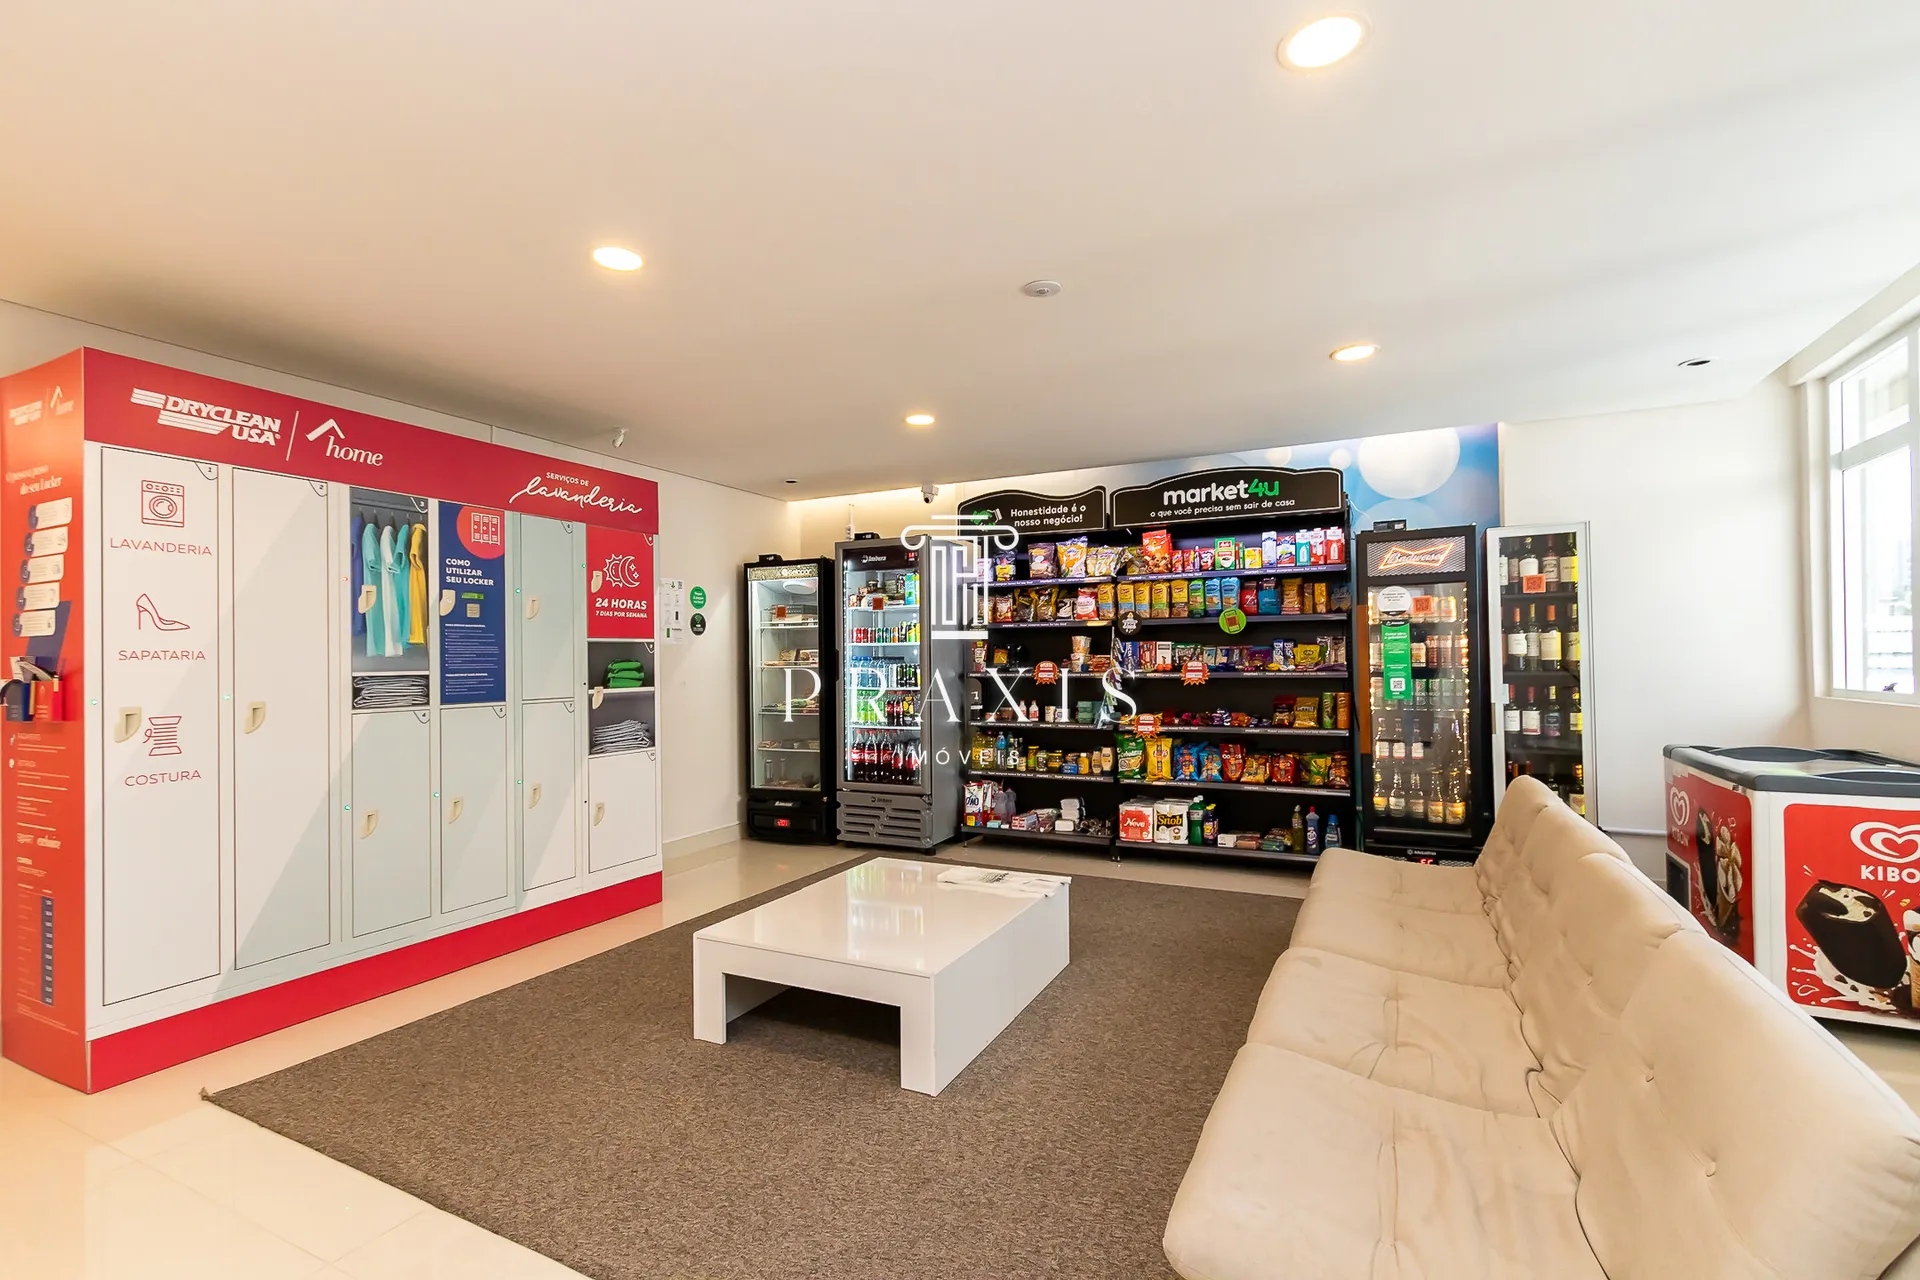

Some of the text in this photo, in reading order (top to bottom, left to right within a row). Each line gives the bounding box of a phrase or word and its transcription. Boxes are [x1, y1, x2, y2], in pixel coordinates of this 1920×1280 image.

[165, 394, 282, 433] DRYCLEAN
[325, 435, 384, 467] home
[546, 471, 590, 487] SERVIÇOS DE
[509, 476, 643, 514] lavanderia
[1163, 478, 1280, 506] market4u
[1010, 504, 1069, 517] Honestidade
[1071, 503, 1077, 513] é
[1157, 509, 1172, 518] que
[1174, 506, 1192, 515] você
[1194, 505, 1224, 515] precisa
[1243, 501, 1260, 510] sair
[1261, 500, 1273, 508] de
[1275, 499, 1296, 507] casa
[1014, 514, 1083, 527] nosso negócio!
[109, 537, 213, 557] LAVANDERIA
[445, 558, 471, 567] COMO
[445, 567, 483, 577] UTILIZAR
[445, 575, 495, 586] SEU LOCKER
[595, 597, 648, 610] 24 HORAS
[118, 649, 206, 661] SAPATARIA
[124, 768, 202, 788] COSTURA
[1157, 816, 1183, 826] Snob
[1860, 864, 1920, 884] KIBO
